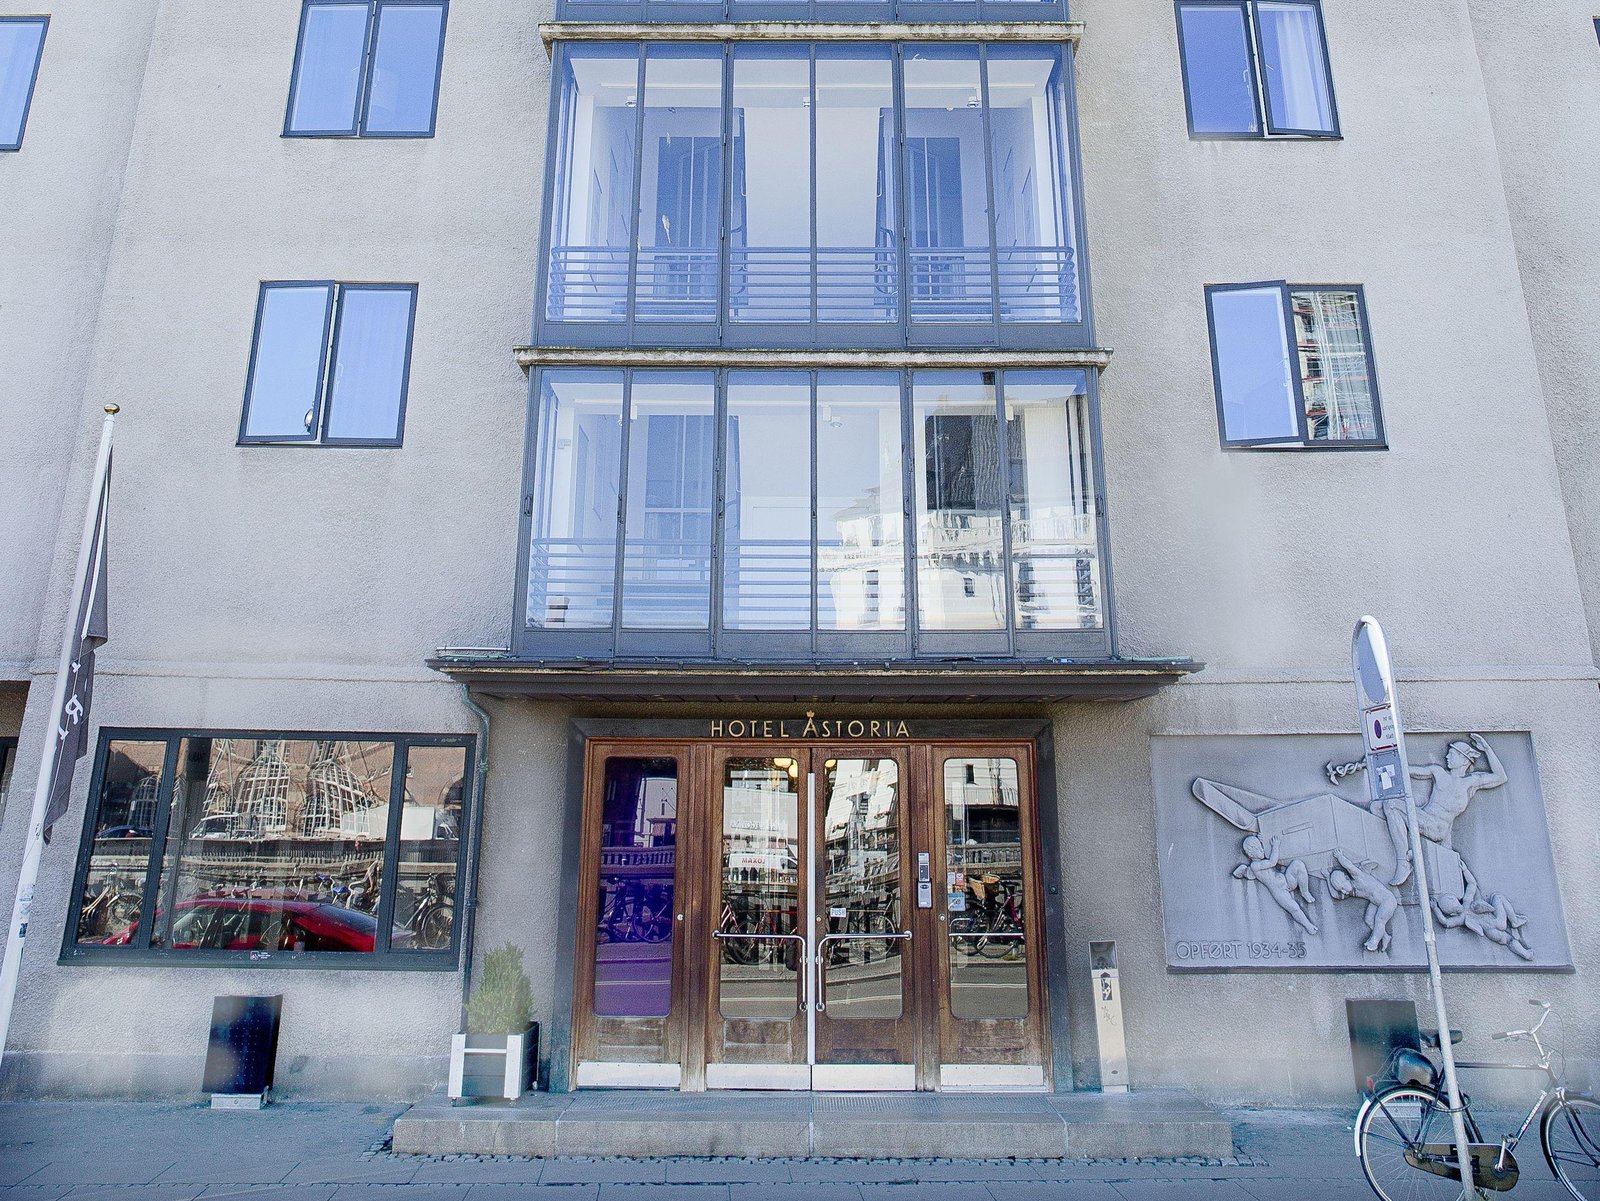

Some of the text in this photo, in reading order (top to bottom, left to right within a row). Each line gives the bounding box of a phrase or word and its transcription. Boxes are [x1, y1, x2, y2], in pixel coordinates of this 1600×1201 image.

[710, 718, 910, 737] HOTEL ASTORIA
[831, 908, 846, 916] PUSH
[1175, 940, 1308, 960] OPFØRT 1934-35
